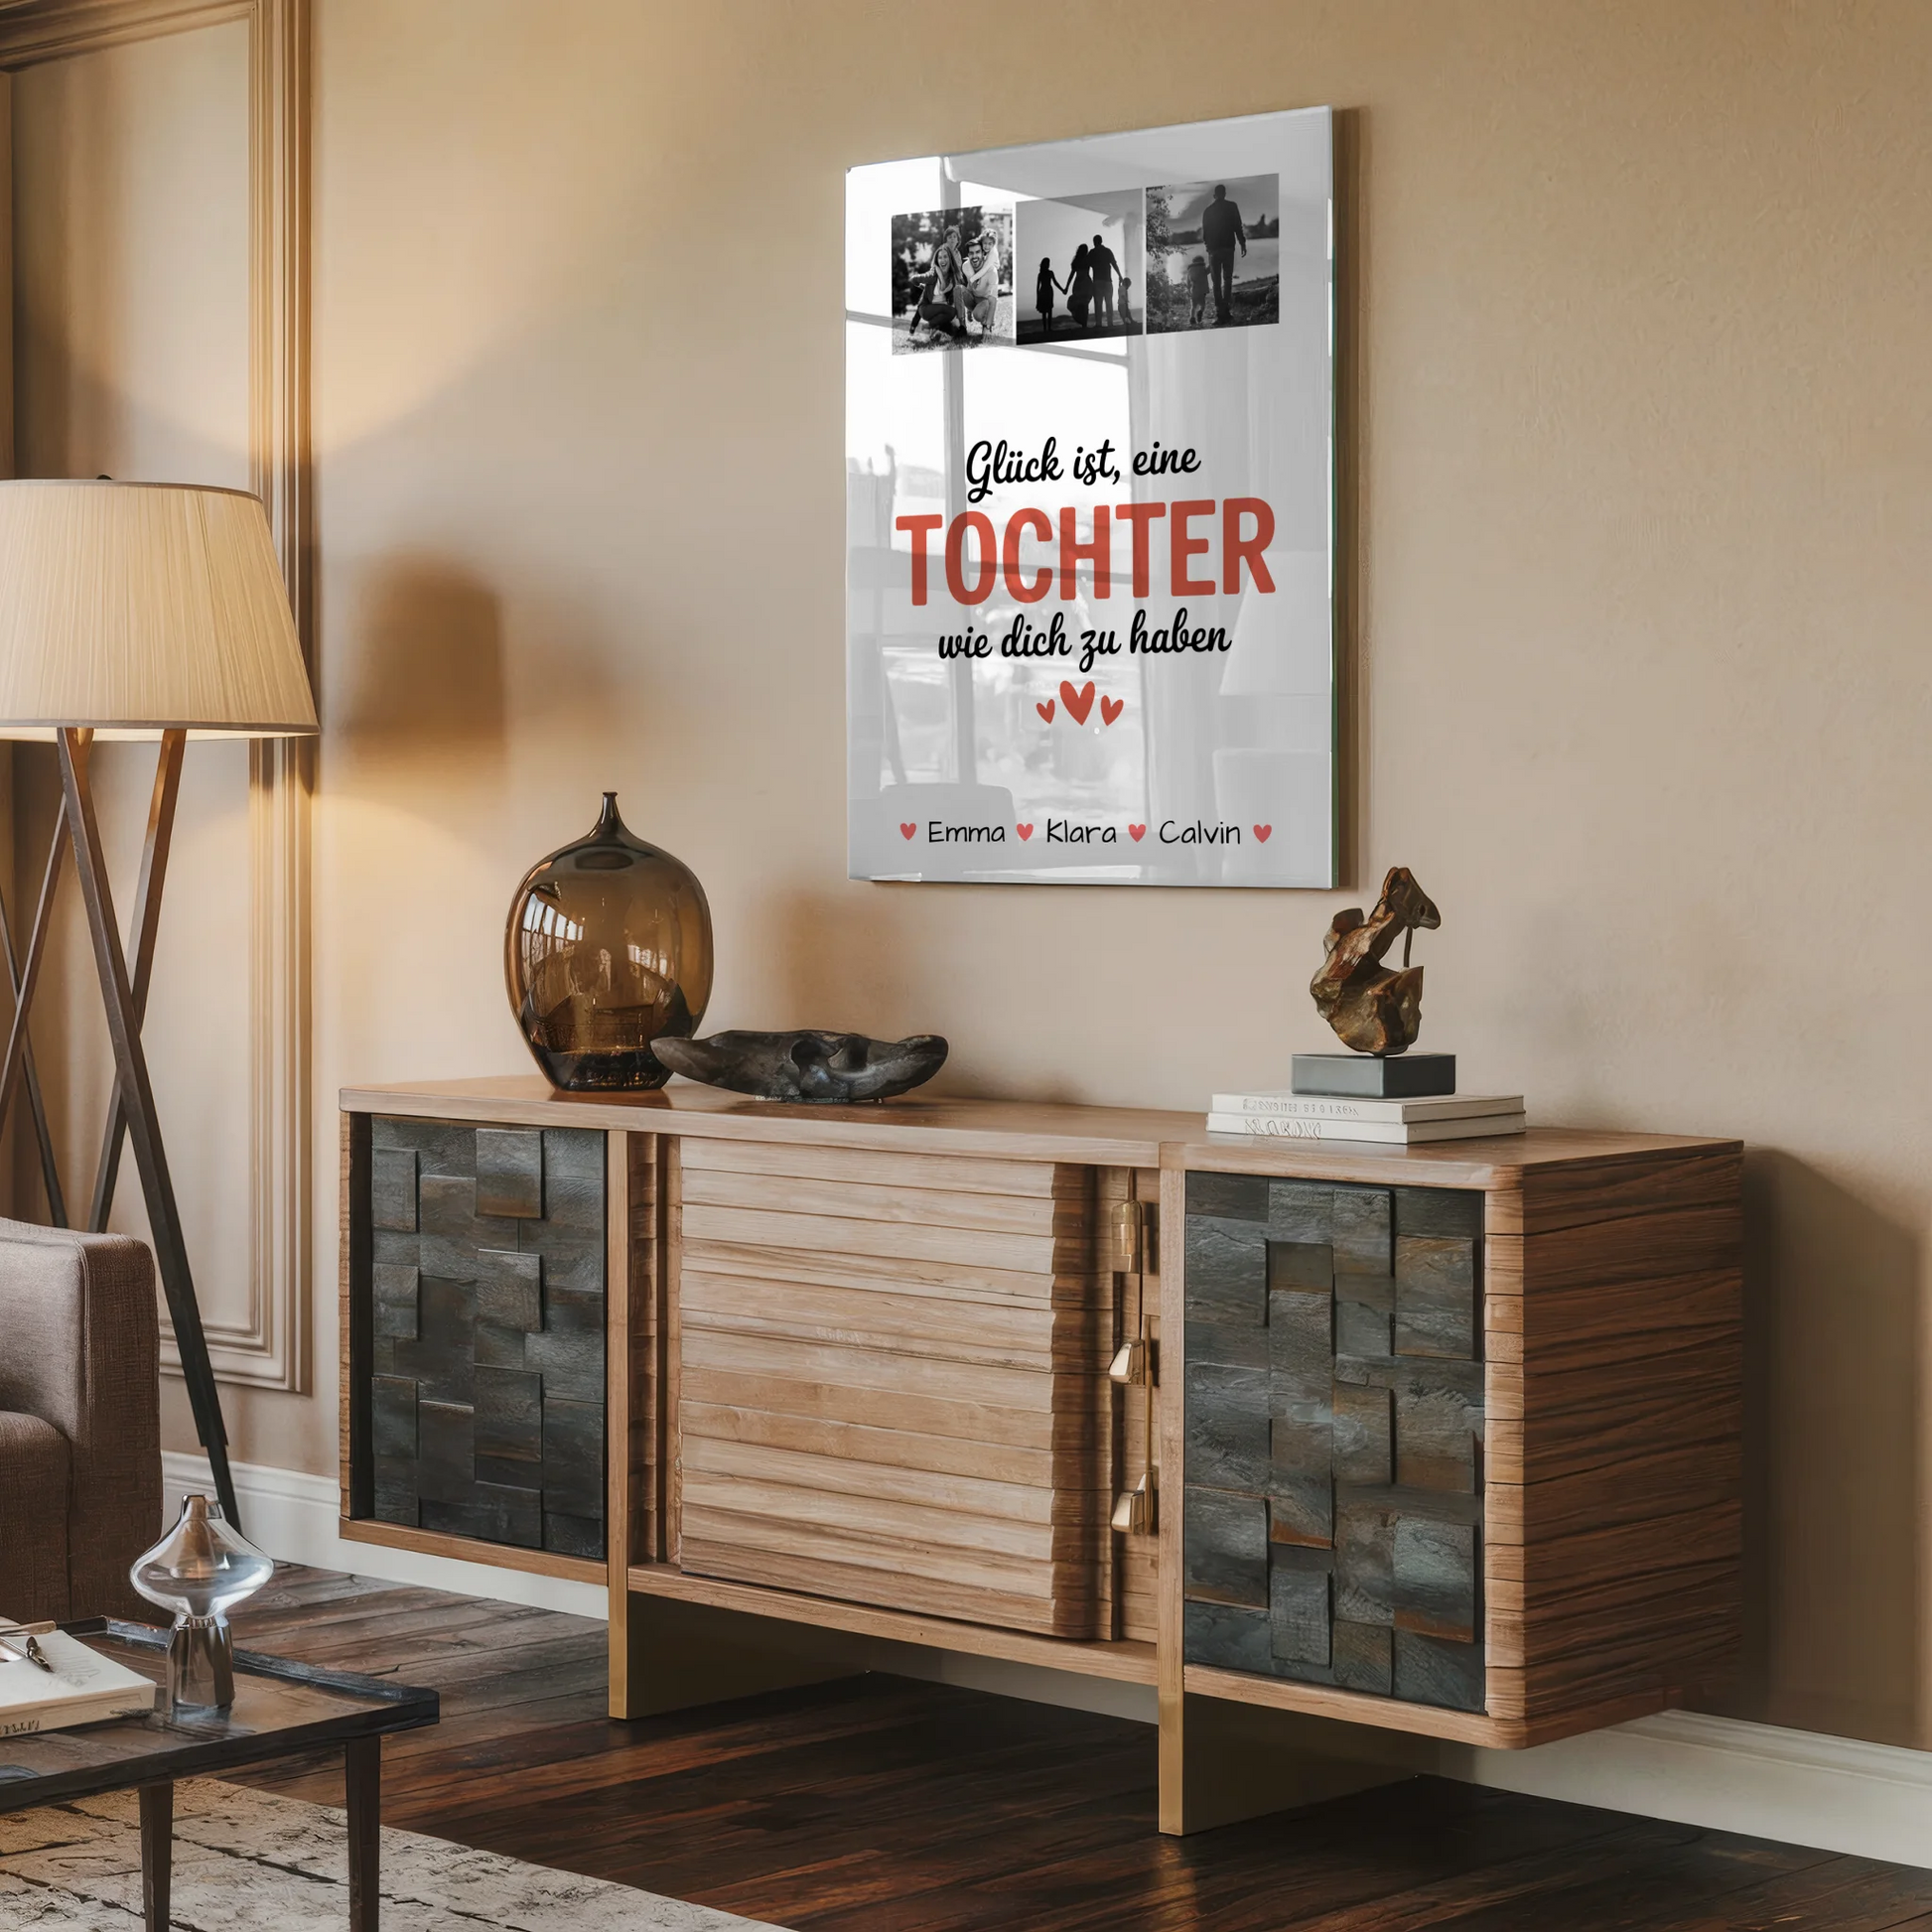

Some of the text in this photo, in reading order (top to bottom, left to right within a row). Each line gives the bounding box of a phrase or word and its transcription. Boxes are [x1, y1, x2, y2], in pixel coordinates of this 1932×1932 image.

[966, 436, 1202, 504] Glück ist, eine
[896, 497, 1276, 607] TOCHTER
[938, 607, 1233, 673] wie dich zu haben
[928, 818, 1241, 845] Emma Klara Calvin
